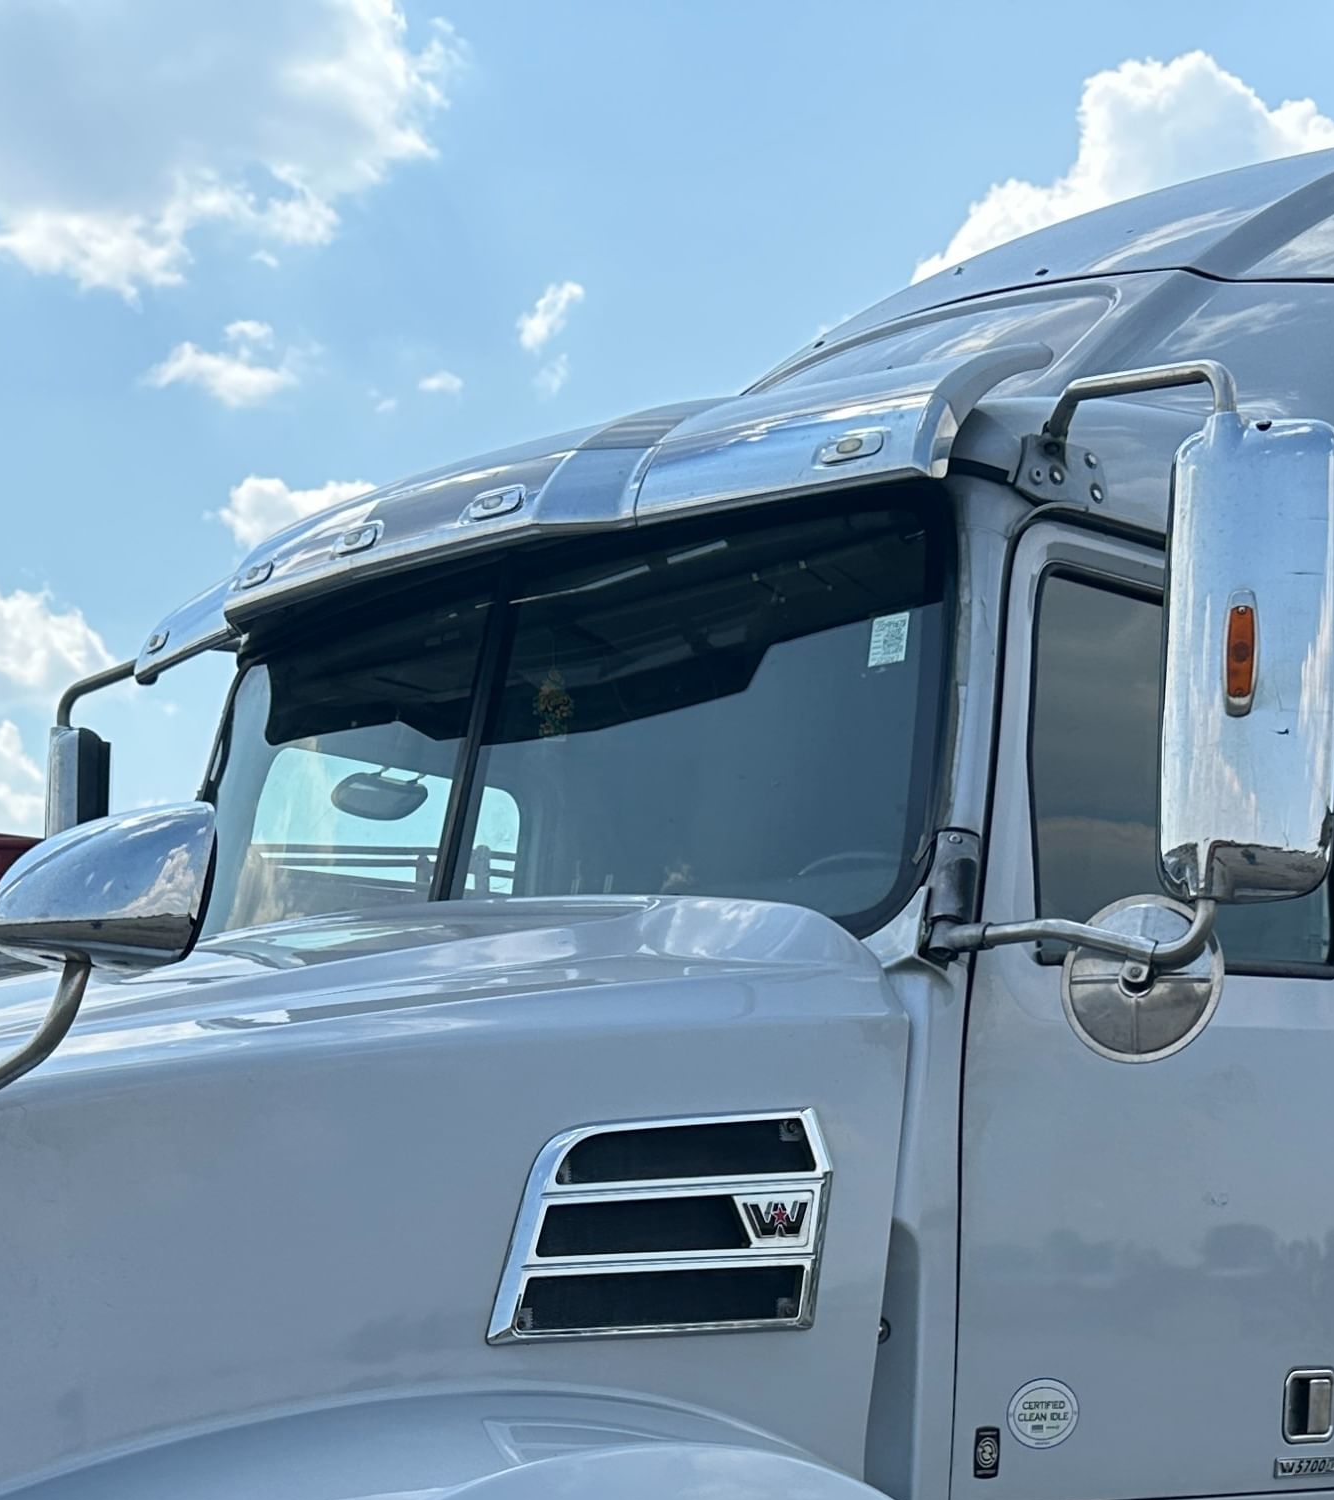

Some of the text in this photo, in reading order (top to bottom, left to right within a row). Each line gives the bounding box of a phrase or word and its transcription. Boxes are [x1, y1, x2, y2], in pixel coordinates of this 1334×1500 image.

[1022, 1400, 1066, 1410] CERTIFIED
[1017, 1411, 1069, 1422] CLEAN IDLE
